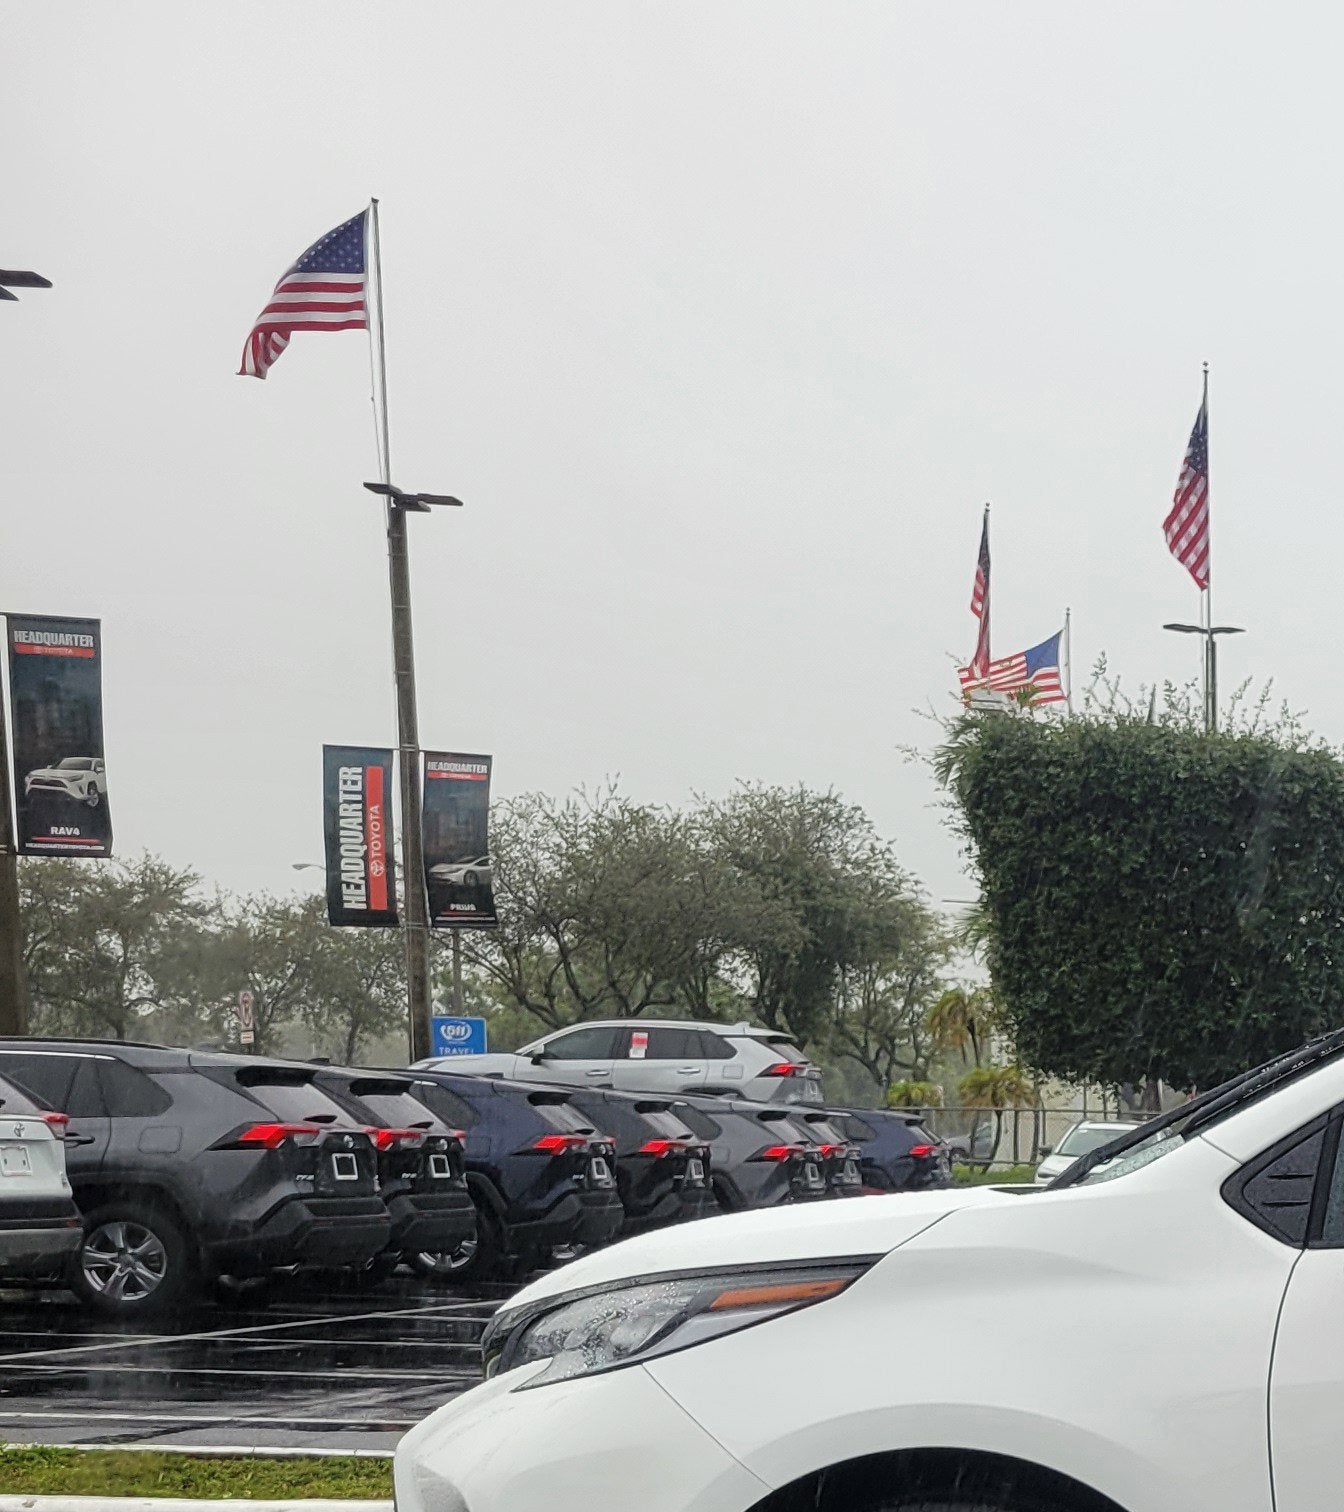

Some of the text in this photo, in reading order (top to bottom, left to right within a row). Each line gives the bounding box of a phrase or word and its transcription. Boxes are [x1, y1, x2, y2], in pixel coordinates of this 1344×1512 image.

[13, 630, 94, 647] HEADQUARTER
[50, 826, 80, 836] RAV4
[338, 766, 367, 910] HEADQUARTER
[370, 805, 381, 858] TOYOTA
